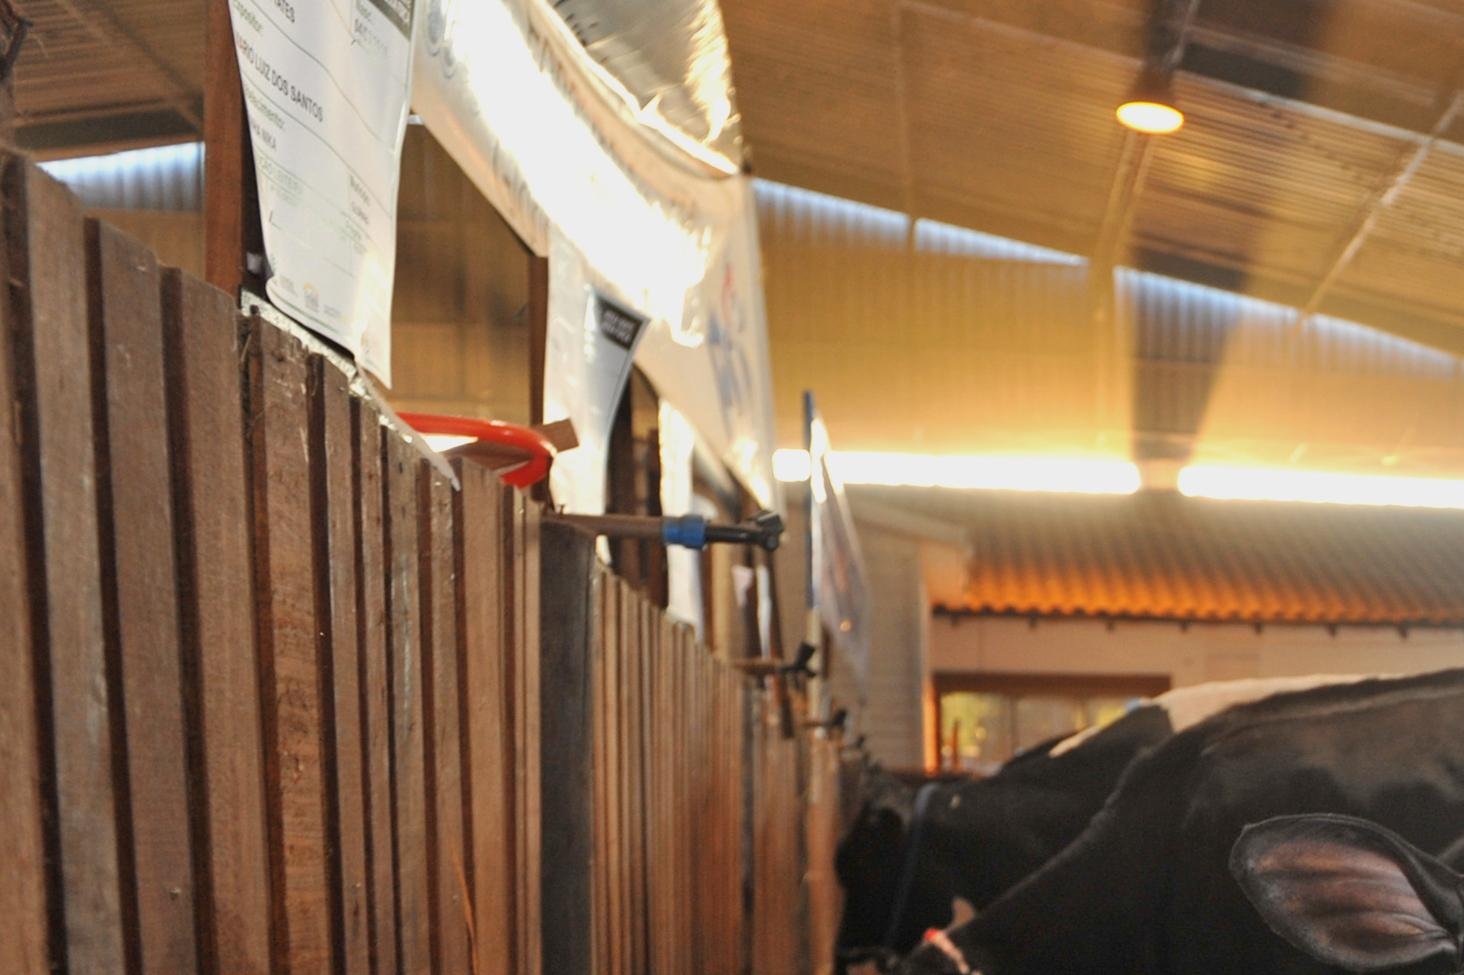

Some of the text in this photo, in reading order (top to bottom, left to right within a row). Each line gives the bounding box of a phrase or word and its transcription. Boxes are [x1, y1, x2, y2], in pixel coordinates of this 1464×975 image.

[255, 53, 271, 82] LUIZ
[271, 69, 289, 96] DOS
[290, 85, 324, 122] SANTOS
